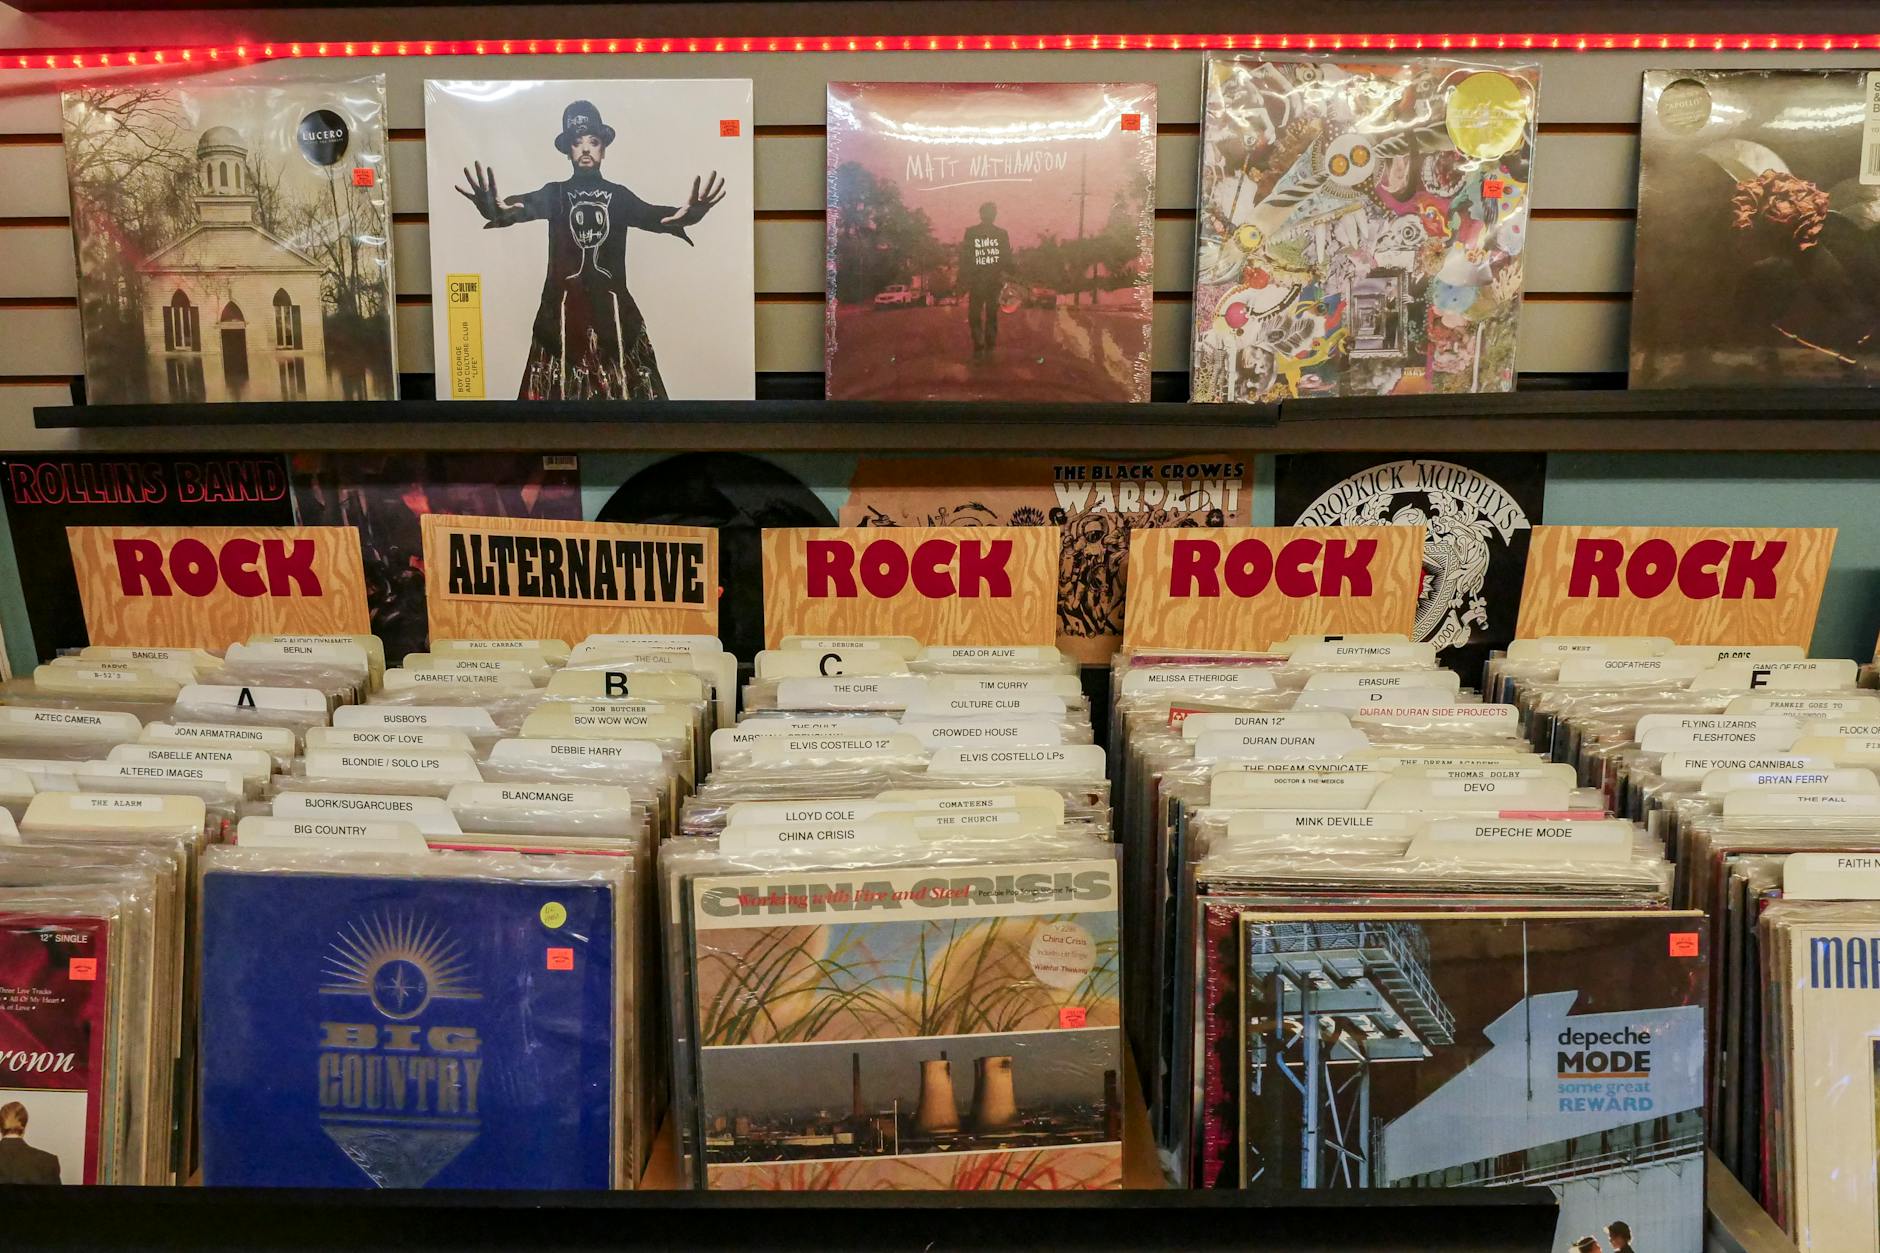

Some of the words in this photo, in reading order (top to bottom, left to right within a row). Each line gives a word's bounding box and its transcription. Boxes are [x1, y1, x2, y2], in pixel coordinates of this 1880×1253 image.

[302, 129, 343, 141] LUCERO
[906, 152, 959, 182] MATT
[969, 150, 1067, 177] NATHANSON
[974, 237, 999, 248] SINGS
[975, 256, 1000, 265] HEART
[463, 344, 471, 376] CULTURE
[1053, 465, 1086, 481] THE
[1092, 464, 1154, 480] BLACK
[1160, 462, 1245, 479] CROWES
[9, 463, 167, 504] ROLLINS
[174, 460, 287, 503] BAND
[1053, 479, 1243, 514] WARPAINT
[1300, 463, 1404, 528] DROPKICK
[1416, 462, 1522, 531] MURPHYS
[113, 538, 323, 597] ROCK
[449, 533, 704, 604] ALTERNATIVE
[806, 539, 1013, 599] ROCK
[1169, 538, 1378, 598] ROCK
[1567, 538, 1788, 600] ROCK
[132, 651, 169, 660] BANGLES
[283, 646, 313, 654] BERLIN
[1336, 647, 1391, 655] EURYTHMICS
[456, 661, 478, 669] JOHN
[479, 661, 501, 669] CALE
[819, 653, 843, 677] C
[1604, 661, 1662, 669] GODFATHERS
[414, 674, 454, 682] CABARET
[455, 674, 498, 683] VOLTAIRE
[1149, 674, 1186, 683] MELISSA
[1188, 674, 1239, 683] ETHERIDGE
[1358, 677, 1401, 686] ERASURE
[1750, 670, 1771, 689] F
[605, 671, 629, 698] B
[833, 685, 852, 693] THE
[853, 684, 879, 693] CURE
[979, 681, 995, 689] TIM
[996, 681, 1029, 689] CURRY
[237, 687, 257, 711] A
[1370, 693, 1383, 701] D
[950, 700, 994, 709] CULTURE
[995, 700, 1020, 708] CLUB
[1359, 708, 1393, 717] DURAN
[1396, 708, 1430, 717] DURAN
[1431, 708, 1455, 716] SIDE
[1456, 708, 1508, 716] PROJECTS
[34, 713, 63, 723] AZTEC
[64, 715, 102, 725] CAMERA
[383, 714, 427, 723] BUSBOYS
[574, 716, 596, 725] BOW
[597, 716, 622, 725] WOW
[623, 716, 648, 725] WOW
[1234, 717, 1268, 726] DURAN
[1681, 720, 1715, 729] FLYING
[1717, 720, 1757, 729] LIZARDS
[174, 728, 198, 737] JOAN
[200, 728, 263, 740] ARMATRADING
[932, 728, 982, 737] CROWDED
[984, 728, 1018, 737] HOUSE
[1839, 726, 1869, 735] FLOCK
[353, 733, 381, 743] BOOK
[382, 734, 396, 743] OF
[398, 734, 424, 744] LOVE
[1242, 736, 1277, 745] DURAN
[1280, 736, 1315, 745] DURAN
[1693, 733, 1756, 742] FLESHTONES
[550, 745, 586, 755] DEBBIE
[588, 747, 622, 756] HARRY
[790, 741, 818, 750] ELVIS
[820, 740, 873, 749] COSTELLO
[149, 750, 192, 760] ISABELLE
[194, 751, 233, 761] ANTENA
[960, 753, 989, 762] ELVIS
[990, 752, 1045, 762] COSTELLO
[1046, 752, 1065, 761] LPs
[342, 757, 384, 767] BLONDIE
[391, 759, 419, 768] SOLO
[421, 759, 440, 769] LPS
[1243, 764, 1265, 772] THE
[1267, 764, 1305, 772] DREAM
[1308, 764, 1369, 772] SYNDICATE
[1685, 759, 1708, 769] FINE
[1710, 760, 1746, 769] YOUNG
[1748, 760, 1804, 769] CANNIBALS
[119, 767, 164, 777] ALTERED
[166, 769, 204, 779] IMAGES
[1758, 775, 1792, 785] BRYAN
[1795, 775, 1829, 784] FERRY
[1463, 783, 1495, 792] DEVO
[502, 790, 574, 802] BLANCMANGE
[91, 799, 109, 807] THE
[114, 800, 142, 808] ALARM
[305, 798, 413, 811] BJORK/SUGARCUBES
[939, 800, 993, 809] COMATEENS
[786, 811, 823, 821] LLOYD
[825, 810, 855, 820] COLE
[936, 817, 955, 825] THE
[960, 815, 998, 824] CHURCH
[1295, 817, 1324, 827] MINK
[1327, 817, 1374, 827] DEVILLE
[294, 824, 313, 835] BIG
[315, 825, 367, 836] COUNTRY
[1475, 827, 1533, 838] DEPECHE
[1536, 827, 1573, 838] MODE
[778, 831, 814, 842] CHINA
[816, 830, 855, 841] CRISIS
[1838, 858, 1871, 868] FAITH
[701, 880, 903, 917] CHINA
[911, 871, 1112, 908] CRISIS
[739, 890, 808, 908] Working
[55, 934, 88, 944] SINGLE
[1042, 934, 1064, 944] China
[1065, 936, 1087, 946] Crisis
[319, 1022, 483, 1053] BIG
[1557, 1026, 1651, 1050] depeche
[1557, 1050, 1651, 1073] MODE
[318, 1053, 483, 1114] COUNTRY
[1557, 1082, 1601, 1094] some
[1606, 1080, 1651, 1097] great
[1559, 1096, 1654, 1112] REWARD
